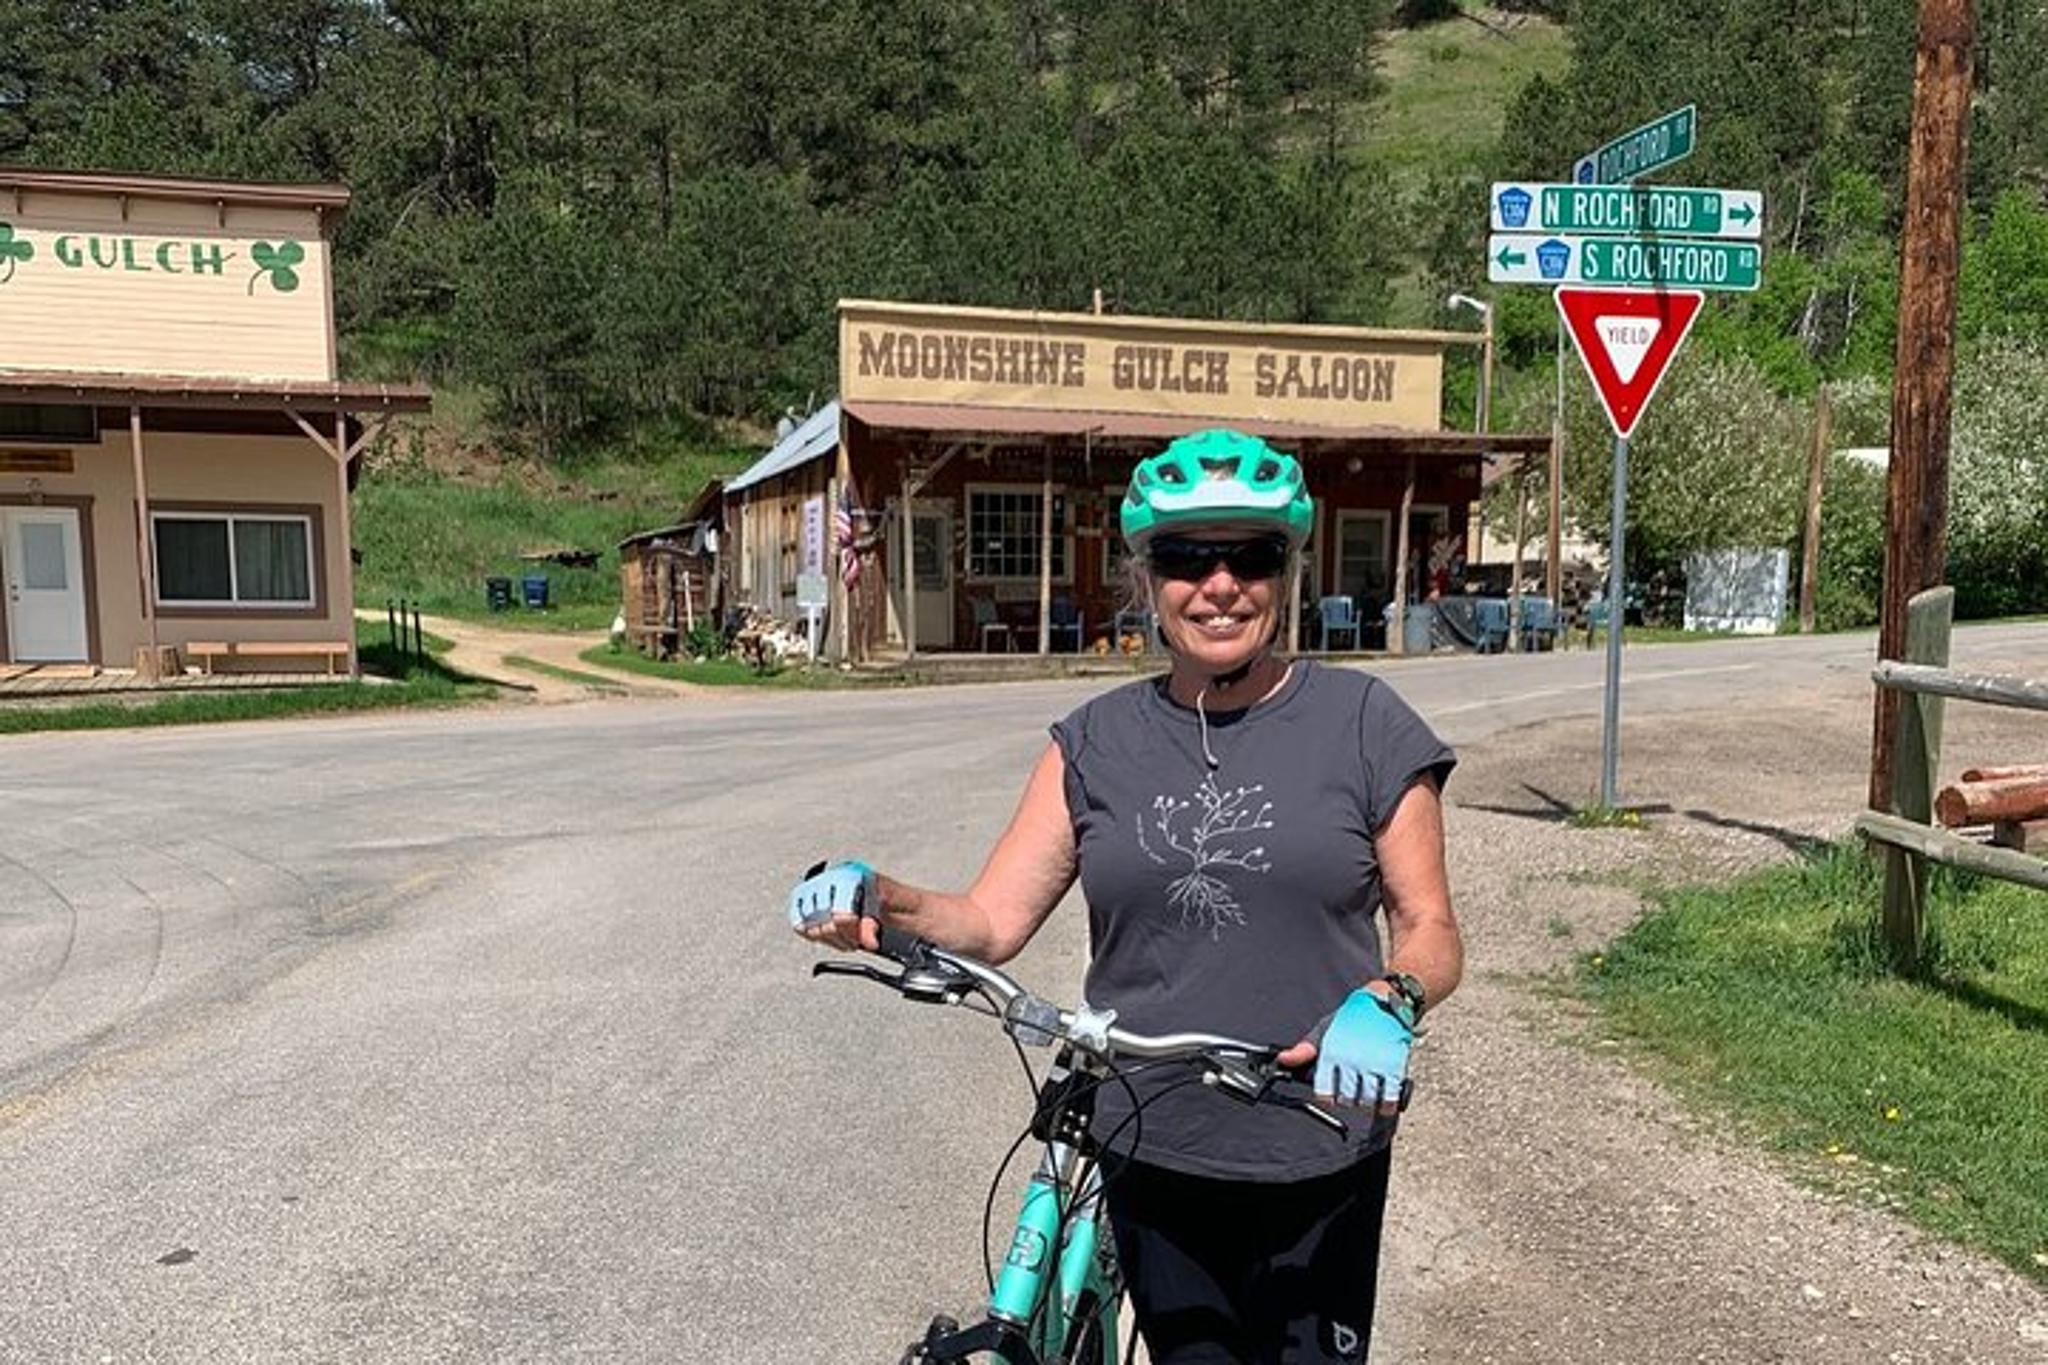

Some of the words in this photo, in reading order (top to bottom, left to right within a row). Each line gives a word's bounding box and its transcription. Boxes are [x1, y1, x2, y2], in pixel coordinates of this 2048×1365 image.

[1544, 191, 1560, 226] N
[1573, 192, 1692, 229] ROCHFORD
[55, 235, 223, 275] GULCH
[1584, 243, 1599, 277] S
[1612, 244, 1728, 282] ROCHFORD
[1607, 326, 1650, 345] YIELD
[858, 331, 1085, 387] MOONSHINE
[1113, 345, 1230, 394] GULCH
[1255, 354, 1396, 401] SALOON
